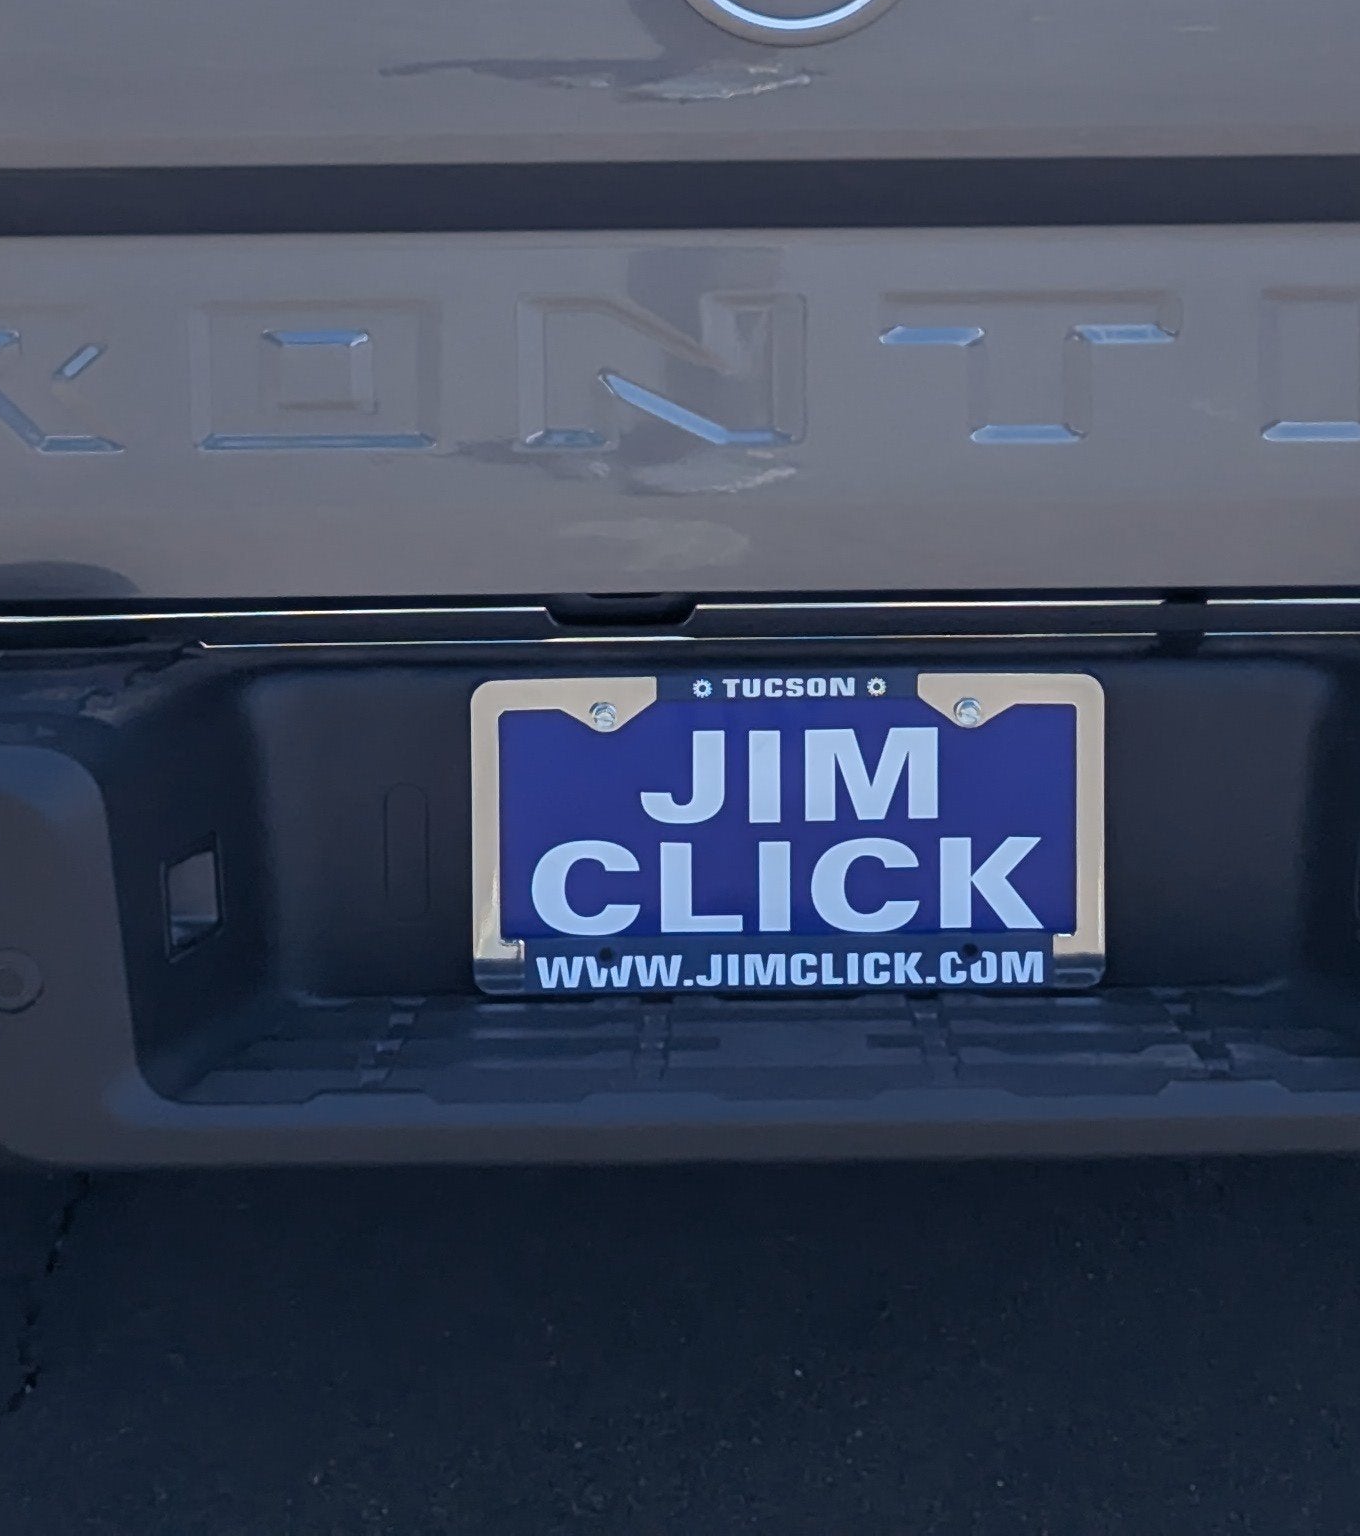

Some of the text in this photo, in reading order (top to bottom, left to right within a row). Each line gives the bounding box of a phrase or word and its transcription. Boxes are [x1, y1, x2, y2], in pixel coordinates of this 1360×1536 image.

[722, 676, 856, 699] TUCSON
[640, 726, 939, 824] JIM
[531, 835, 1045, 936] CLICK
[536, 950, 1045, 989] WWW.JIMCLICK.COM
